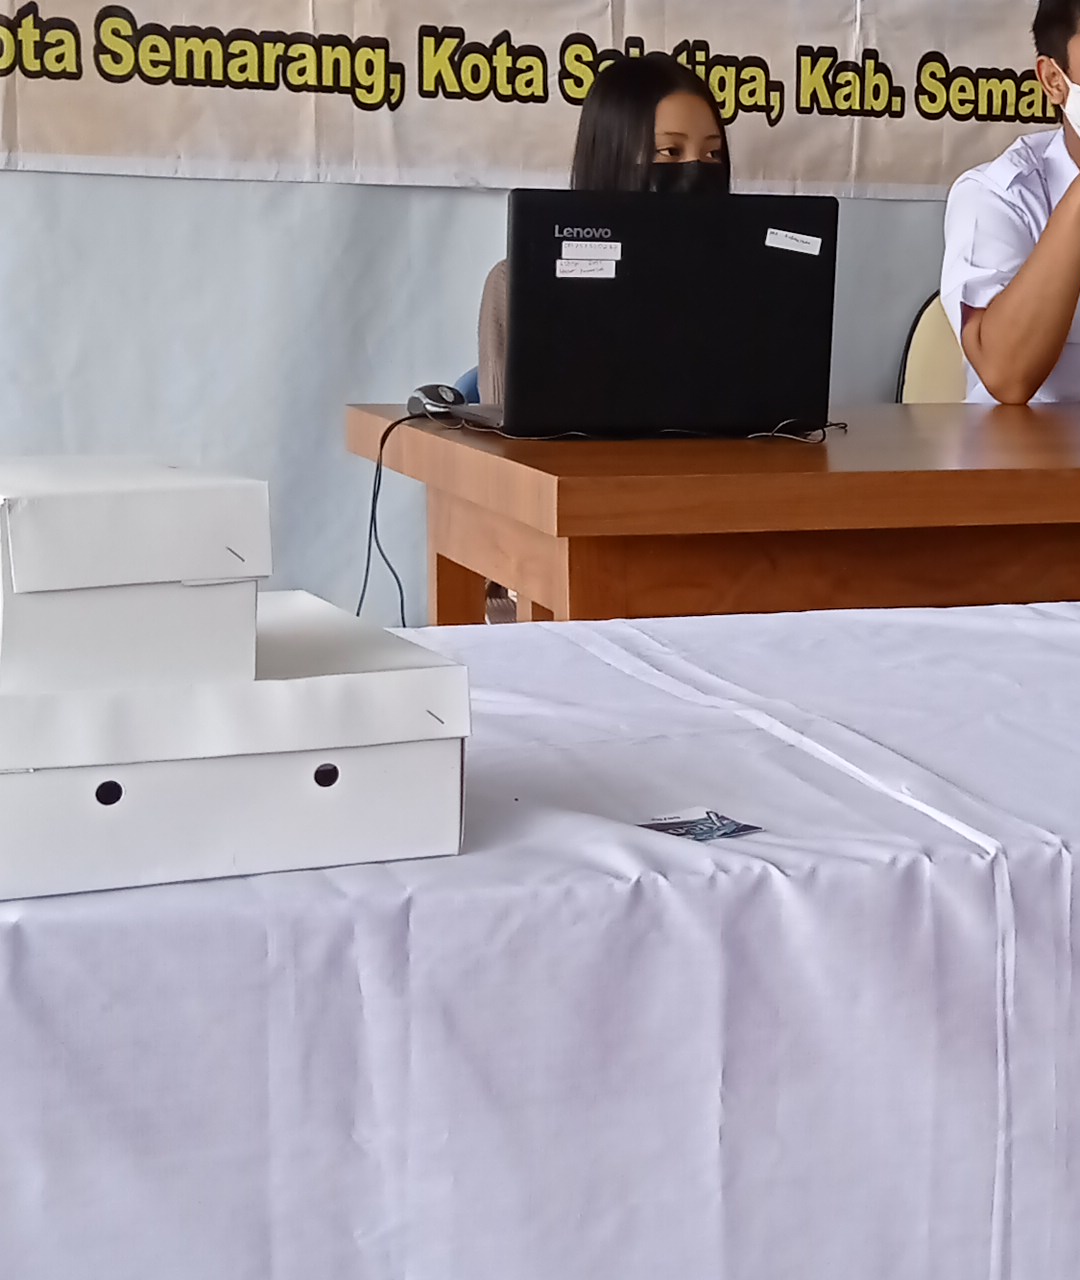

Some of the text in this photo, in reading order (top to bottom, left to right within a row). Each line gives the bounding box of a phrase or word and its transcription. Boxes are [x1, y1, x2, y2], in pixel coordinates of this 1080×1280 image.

[95, 5, 404, 111] Semarang,
[418, 25, 549, 103] Kota
[796, 45, 905, 118] Kab.
[555, 224, 611, 238] Lenovo
